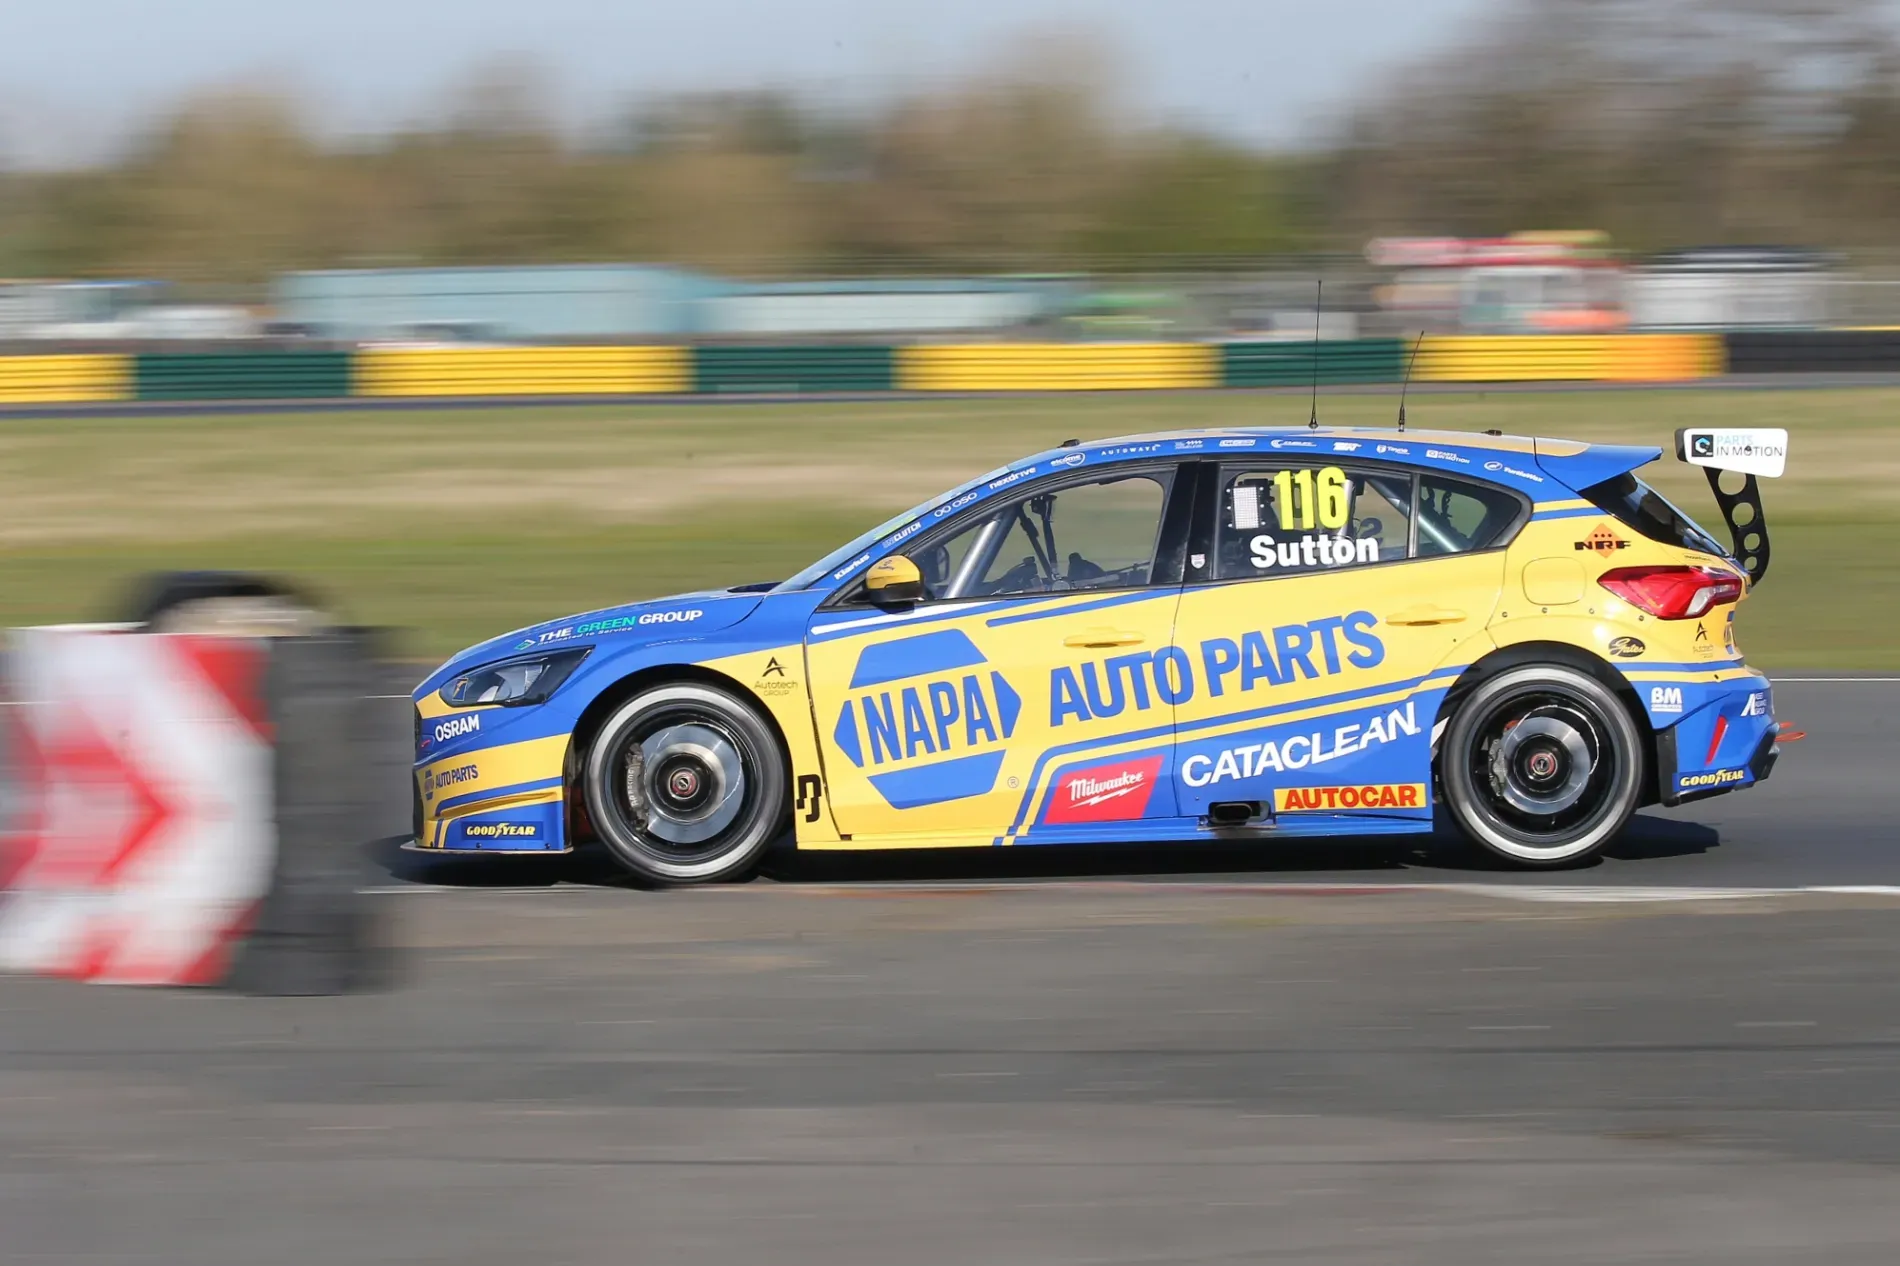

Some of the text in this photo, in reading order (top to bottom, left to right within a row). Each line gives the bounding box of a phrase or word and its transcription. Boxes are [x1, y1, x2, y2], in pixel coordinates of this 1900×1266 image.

[1716, 435, 1754, 446] PARTS
[1716, 446, 1783, 457] IN MOTION
[990, 467, 1036, 490] nexdrive
[1274, 467, 1349, 530] 116
[1249, 534, 1379, 569] Sutton
[1574, 541, 1632, 550] NRF
[538, 610, 703, 643] THE GREEN GROUP
[598, 626, 633, 635] Service
[862, 610, 1386, 765] NAPA AUTO PARTS
[1651, 687, 1682, 704] BM
[434, 714, 480, 742] OSRAM
[1181, 700, 1416, 788] CATACLEAN
[435, 771, 452, 789] AUTO
[451, 764, 479, 784] PARTS
[1066, 771, 1145, 801] Milwaukee
[1680, 769, 1744, 787] GOODYEAR
[1284, 785, 1418, 810] AUTOCAR
[466, 822, 536, 838] GOODYEAR
